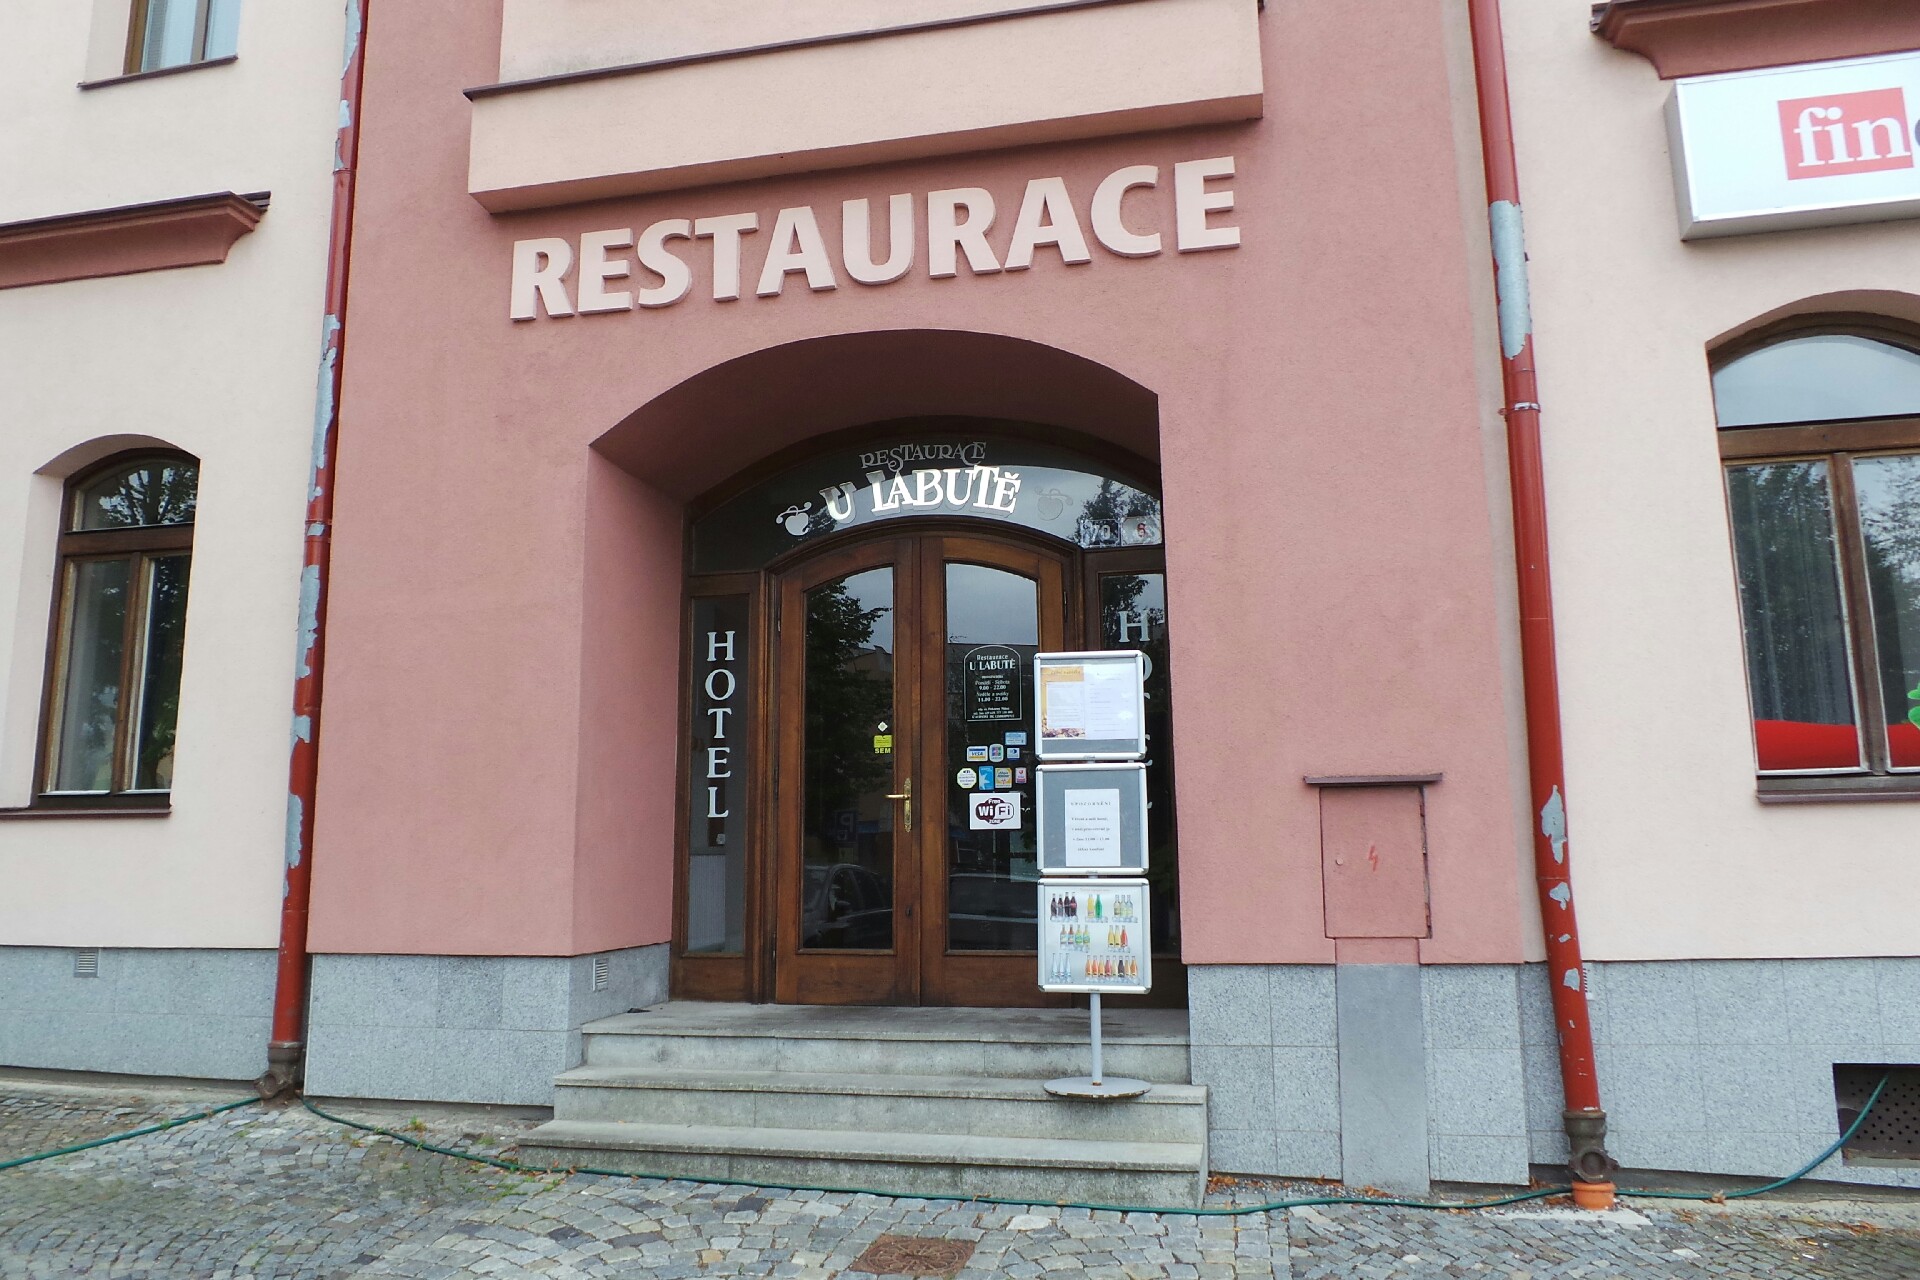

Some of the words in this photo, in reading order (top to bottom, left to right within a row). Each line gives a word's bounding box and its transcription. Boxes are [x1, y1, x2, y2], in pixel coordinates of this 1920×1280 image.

[1793, 106, 1920, 167] fin
[510, 157, 1242, 322] RESTAURACE
[859, 441, 988, 471] RESTAURACE
[819, 481, 857, 521] U
[866, 465, 1022, 517] LABUTĚ
[970, 662, 976, 670] U
[704, 630, 736, 818] HOTEL
